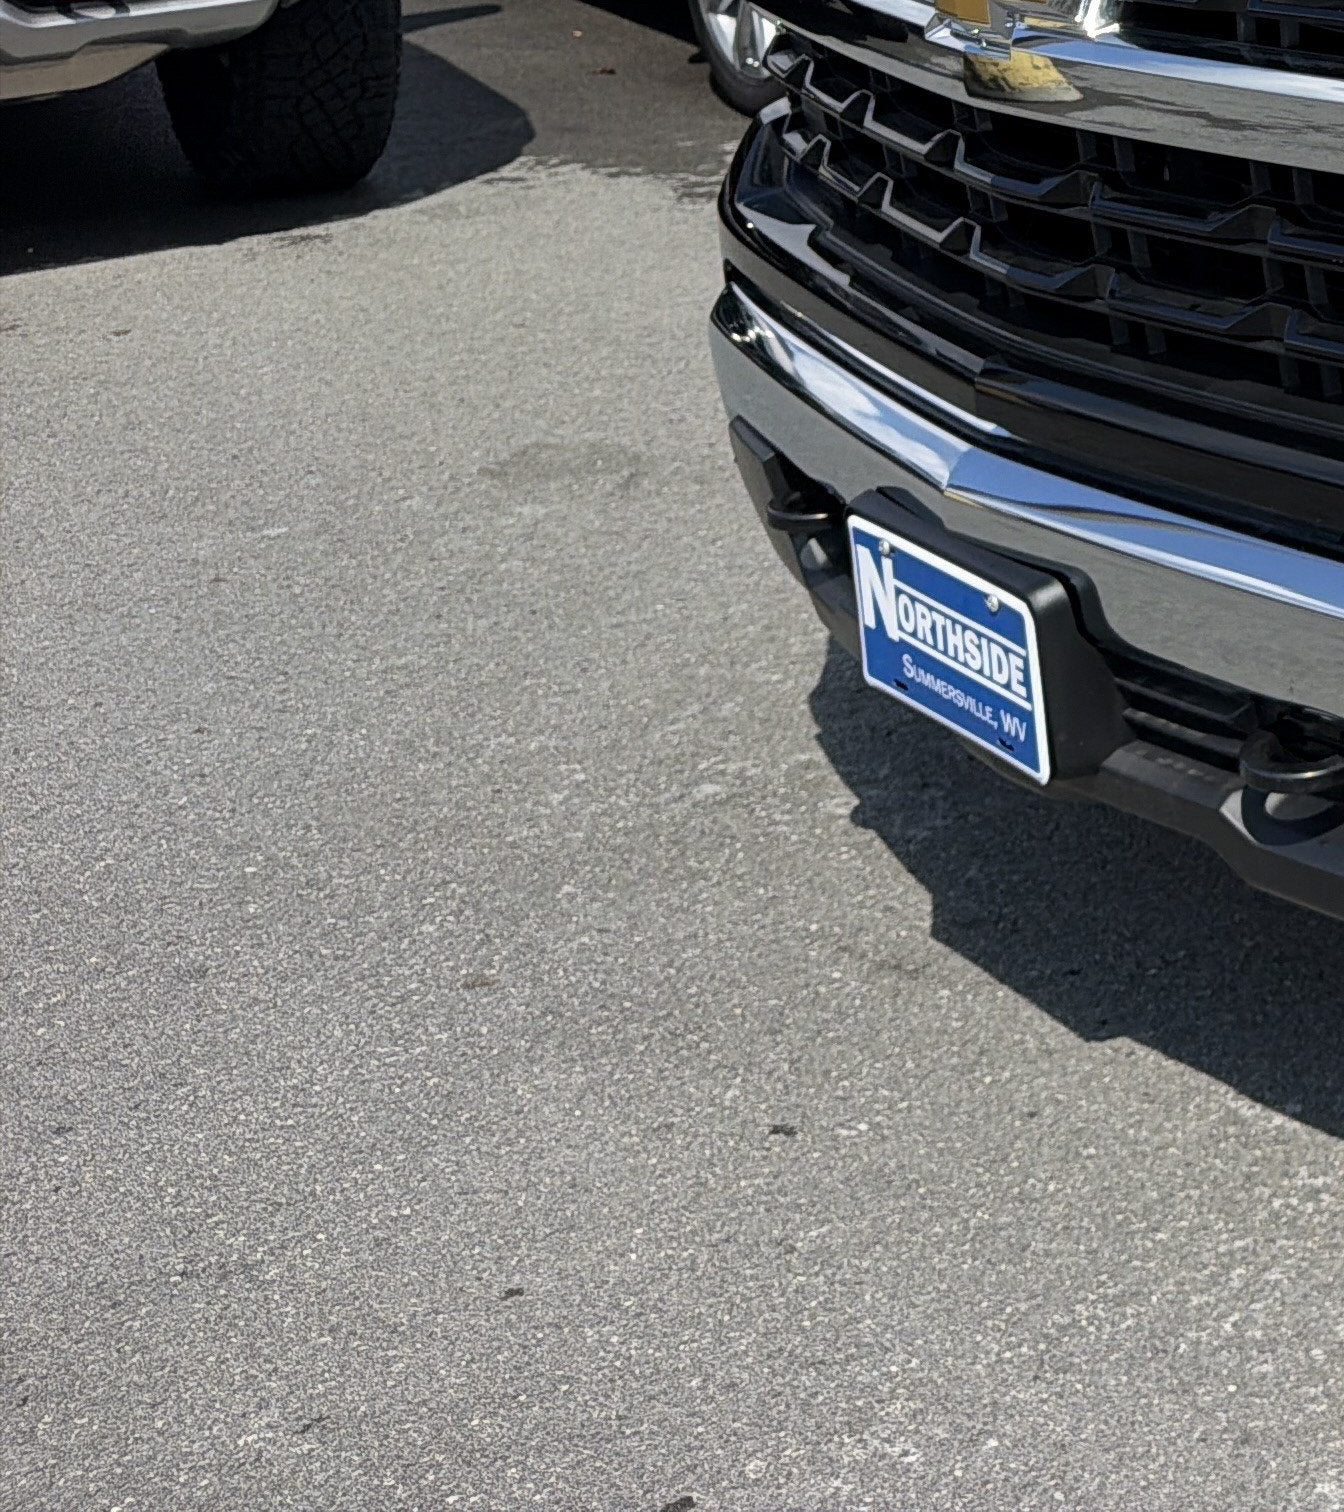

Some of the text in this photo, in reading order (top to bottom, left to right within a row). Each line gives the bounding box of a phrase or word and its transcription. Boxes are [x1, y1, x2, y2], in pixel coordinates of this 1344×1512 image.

[856, 543, 1027, 699] NORTHSIDE
[902, 653, 1027, 743] SUMMERSVILLE, WV
